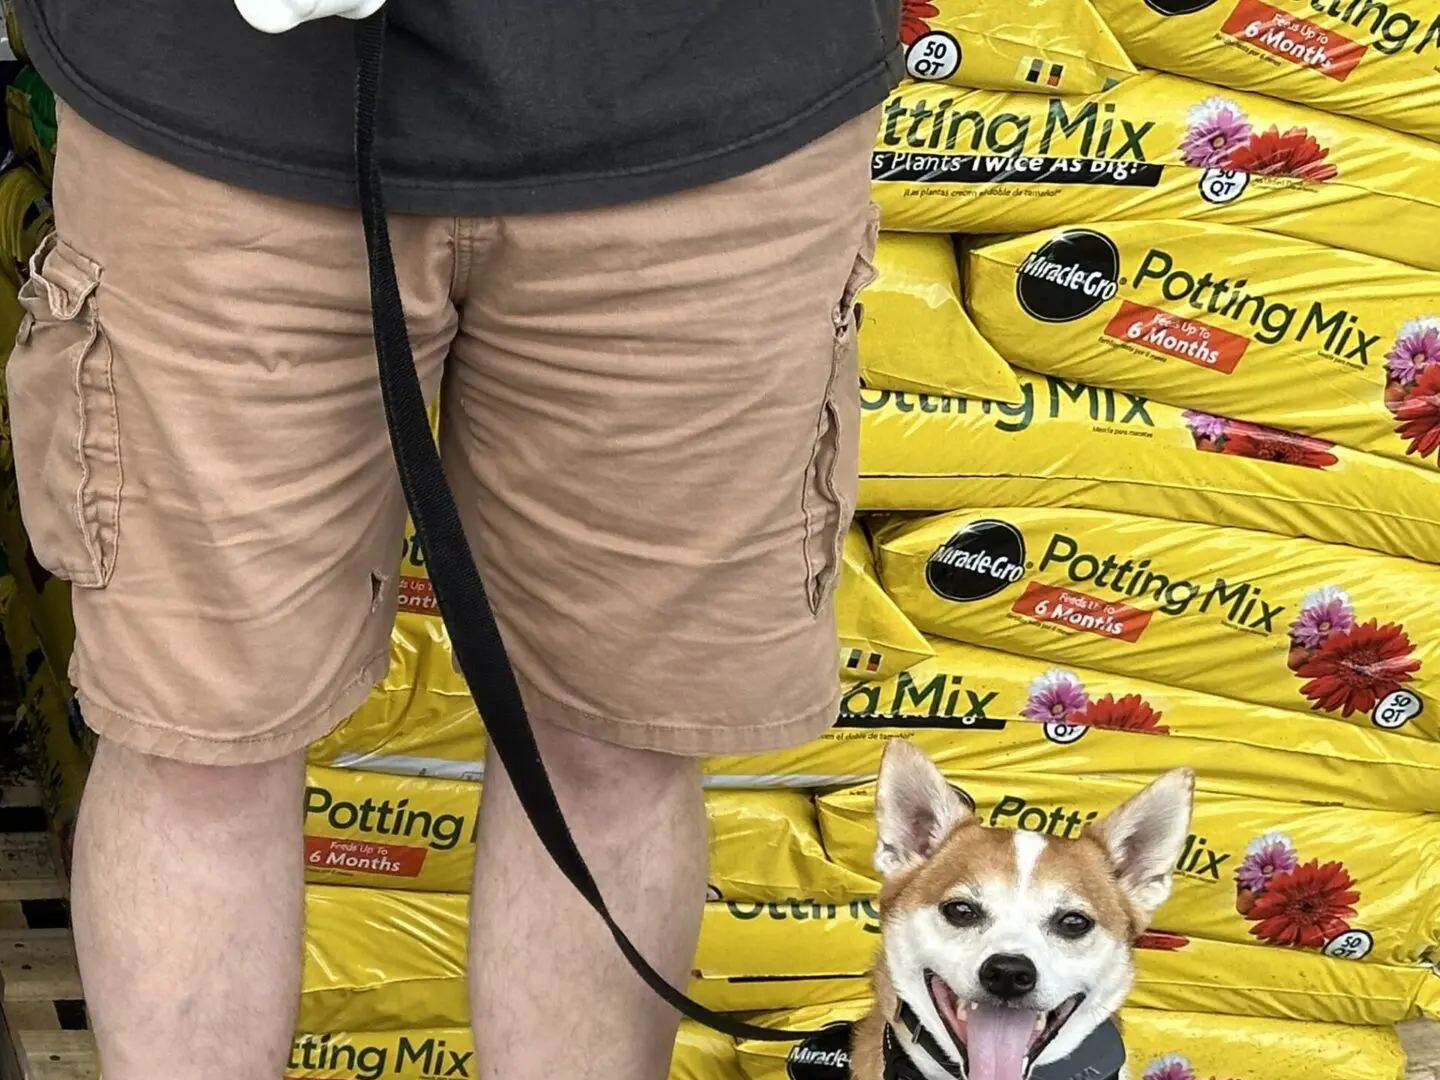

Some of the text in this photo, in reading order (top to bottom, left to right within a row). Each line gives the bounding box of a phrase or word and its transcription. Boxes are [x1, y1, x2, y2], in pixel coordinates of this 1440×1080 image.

[1244, 20, 1262, 39] 6
[1260, 28, 1334, 69] Months
[1299, 24, 1316, 42] Up
[1316, 32, 1329, 45] To
[923, 40, 947, 60] 50
[914, 59, 945, 76] QT
[1039, 98, 1156, 162] Mix
[890, 153, 961, 171] Plants
[920, 187, 949, 198] plantas
[1210, 180, 1236, 197] QT
[1132, 248, 1382, 366] Potting Mix
[1180, 322, 1197, 337] Up
[1198, 326, 1211, 340] To
[1127, 321, 1143, 339] 6
[1142, 327, 1219, 364] Months
[1048, 376, 1155, 427] Mix
[410, 579, 426, 591] Up
[1038, 533, 1285, 633] Potting Mix
[1034, 600, 1051, 616] 6
[1050, 604, 1124, 635] Months
[890, 671, 1000, 719] Mix
[1390, 694, 1412, 708] 50
[1380, 707, 1407, 723] QT
[303, 786, 465, 851] Potting
[329, 840, 389, 857] Feeds Up To
[309, 850, 322, 864] 6
[325, 851, 401, 873] Months
[1340, 935, 1363, 949] 50
[393, 1036, 475, 1079] Mix
